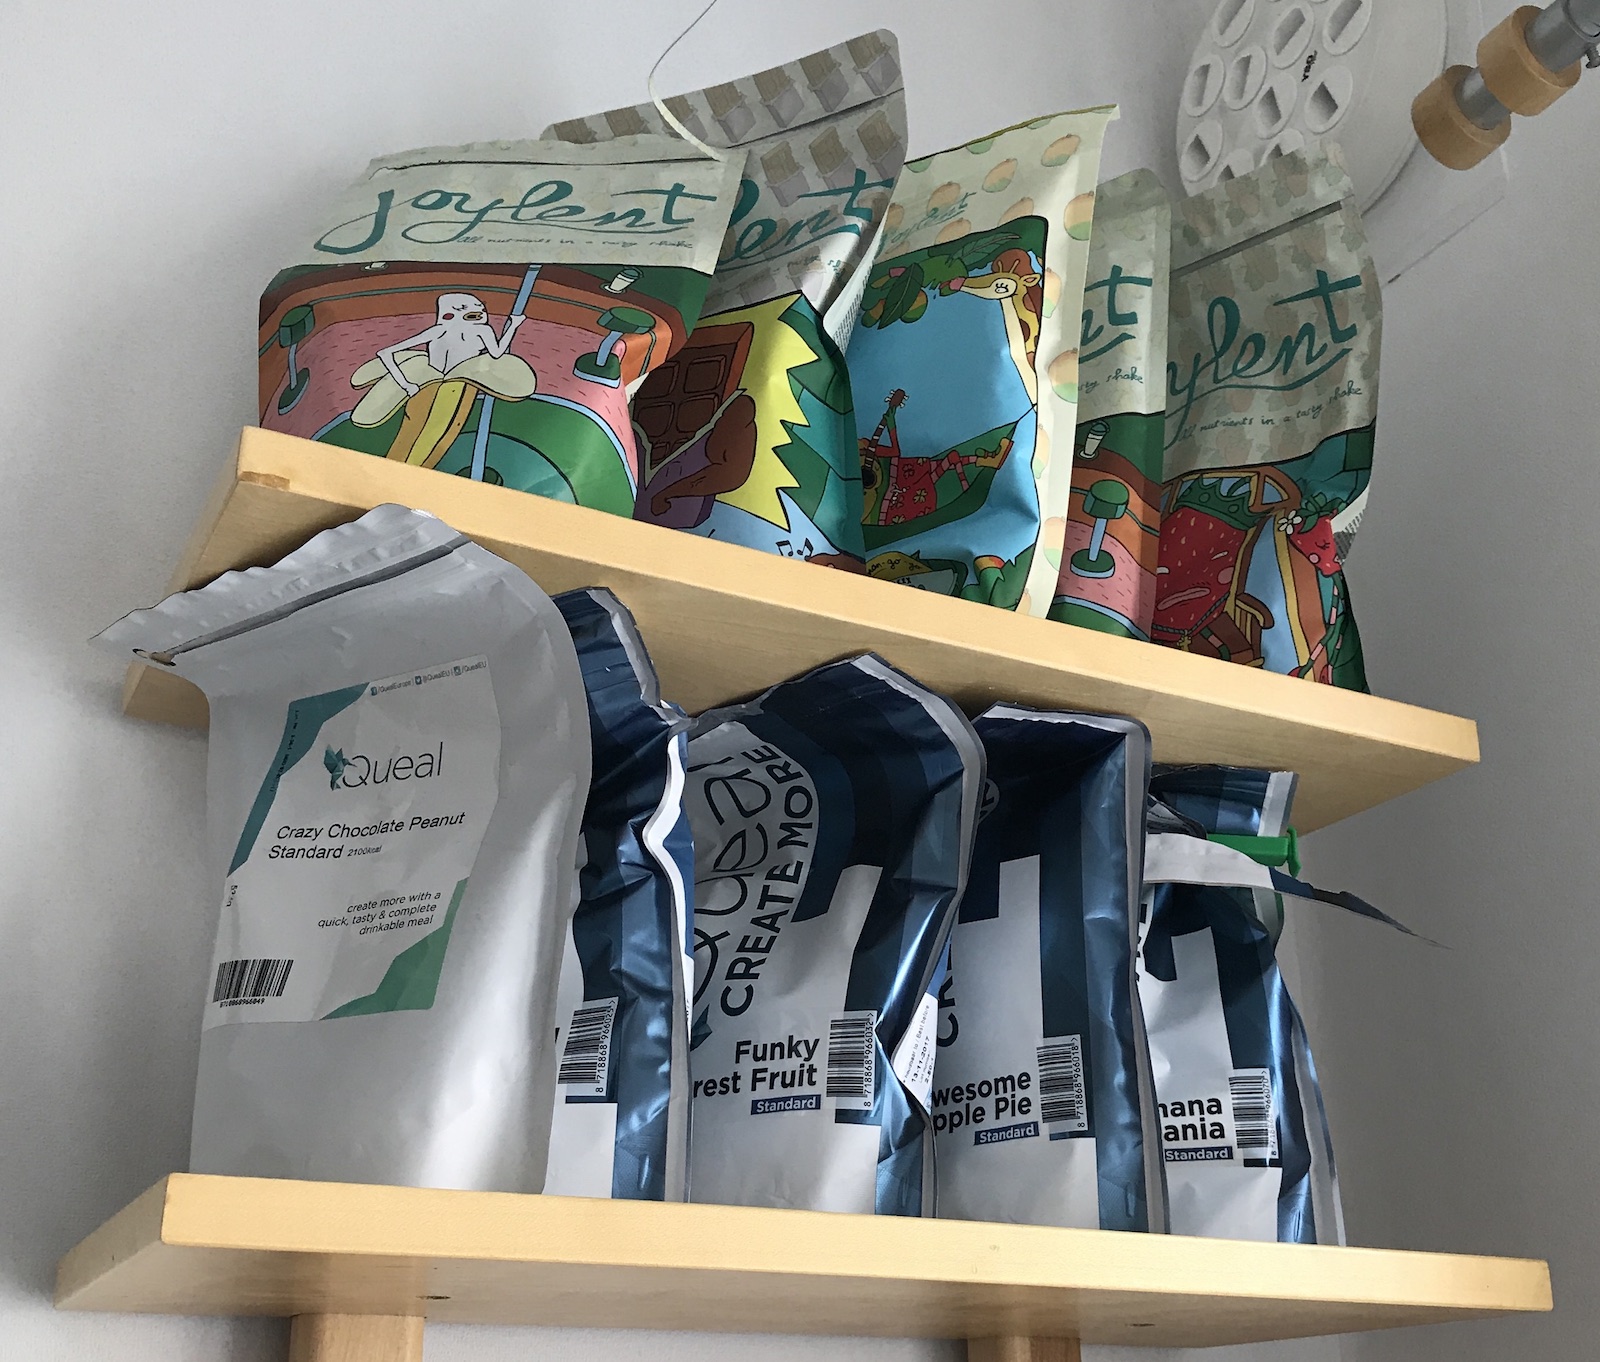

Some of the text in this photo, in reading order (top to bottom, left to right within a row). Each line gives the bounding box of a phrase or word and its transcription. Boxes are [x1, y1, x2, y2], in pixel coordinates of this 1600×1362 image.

[313, 180, 717, 254] joylent
[1107, 366, 1144, 384] shake
[1261, 415, 1276, 426] in
[1329, 379, 1363, 404] shake
[342, 741, 443, 789] Queal
[277, 812, 466, 842] Crazy Chocolate Peanut
[268, 844, 344, 860] Standard
[720, 743, 814, 1018] CREATE MORE
[347, 890, 442, 913] create more with a
[318, 903, 437, 929] quick, tasty & complete
[359, 914, 433, 936] drinkable meal
[735, 1035, 820, 1064] Funky
[693, 1064, 818, 1099] rest Fruit
[933, 1071, 1031, 1108] wesome
[756, 1096, 816, 1113] Standard
[934, 1096, 1032, 1136] pple Pie
[979, 1125, 1036, 1143] Standard
[1164, 1117, 1225, 1142] ania
[1166, 1147, 1229, 1161] Standard
